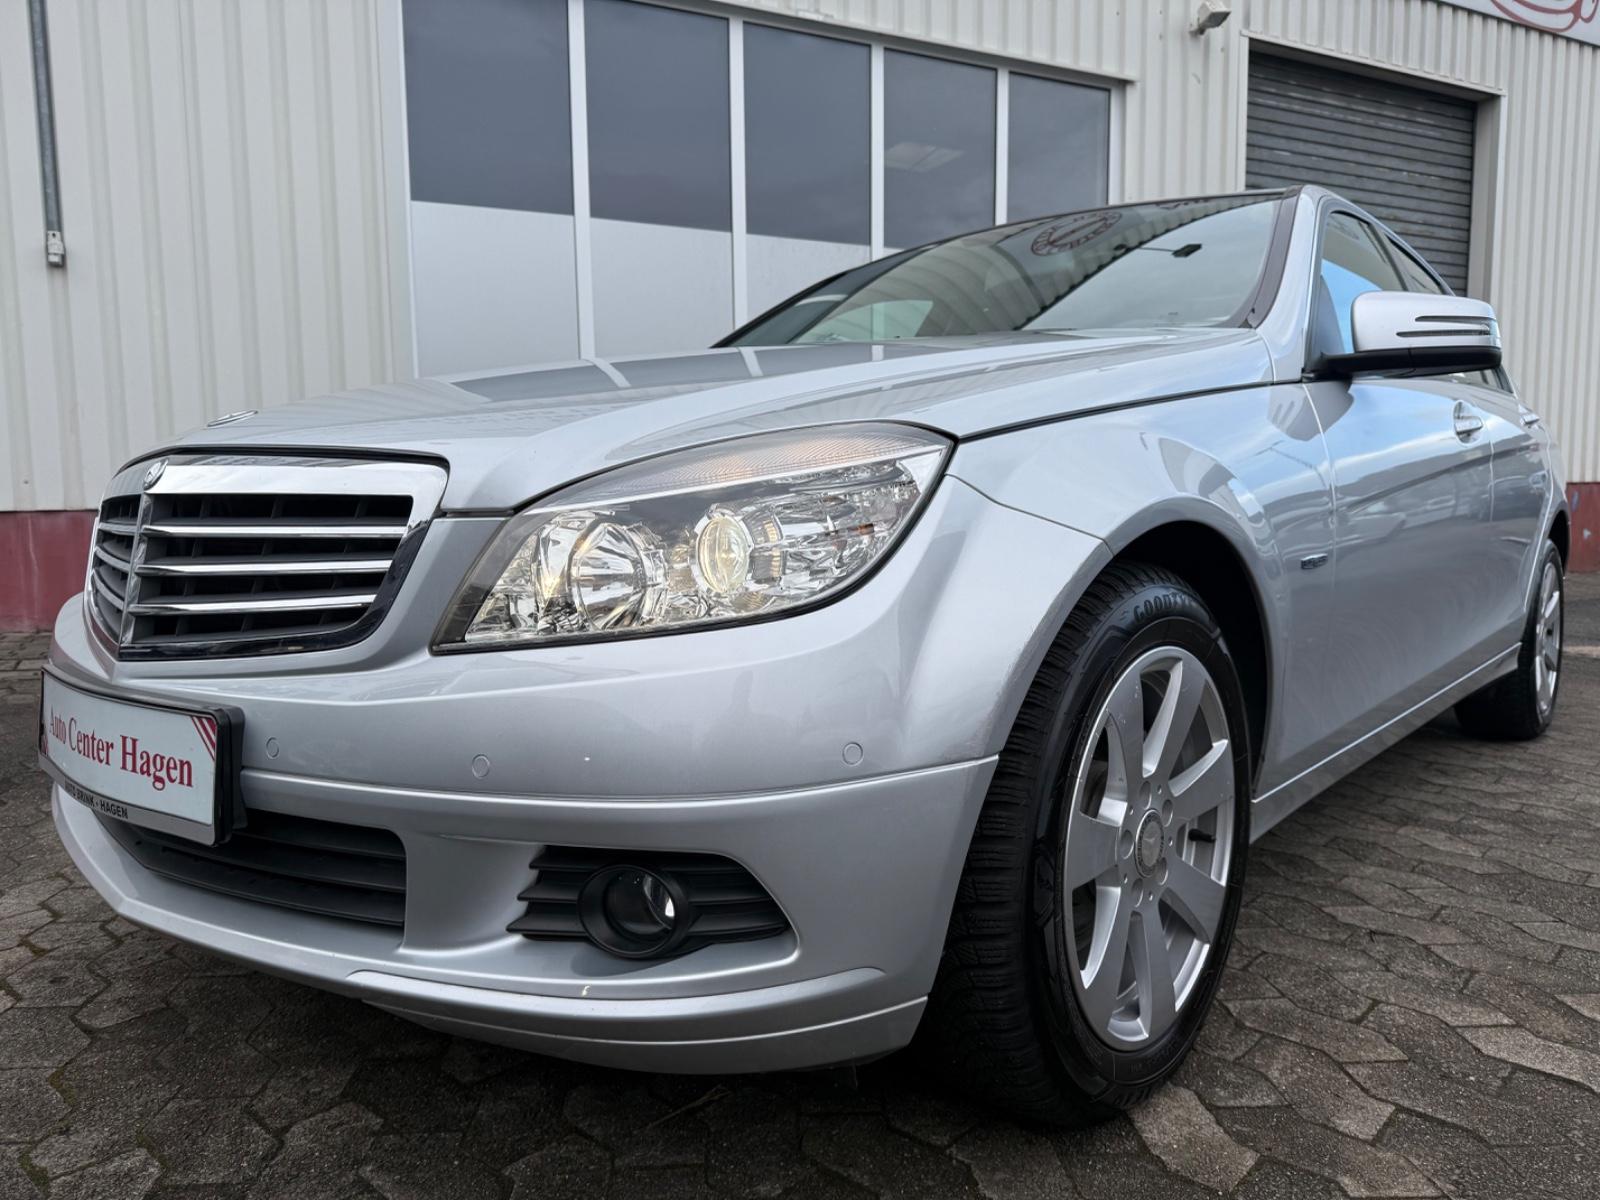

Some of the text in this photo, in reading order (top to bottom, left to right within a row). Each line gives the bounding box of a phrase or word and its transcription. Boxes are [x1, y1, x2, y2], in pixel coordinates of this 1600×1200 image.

[50, 704, 193, 791] Auto Center Hagen
[100, 799, 129, 820] HAGEN
